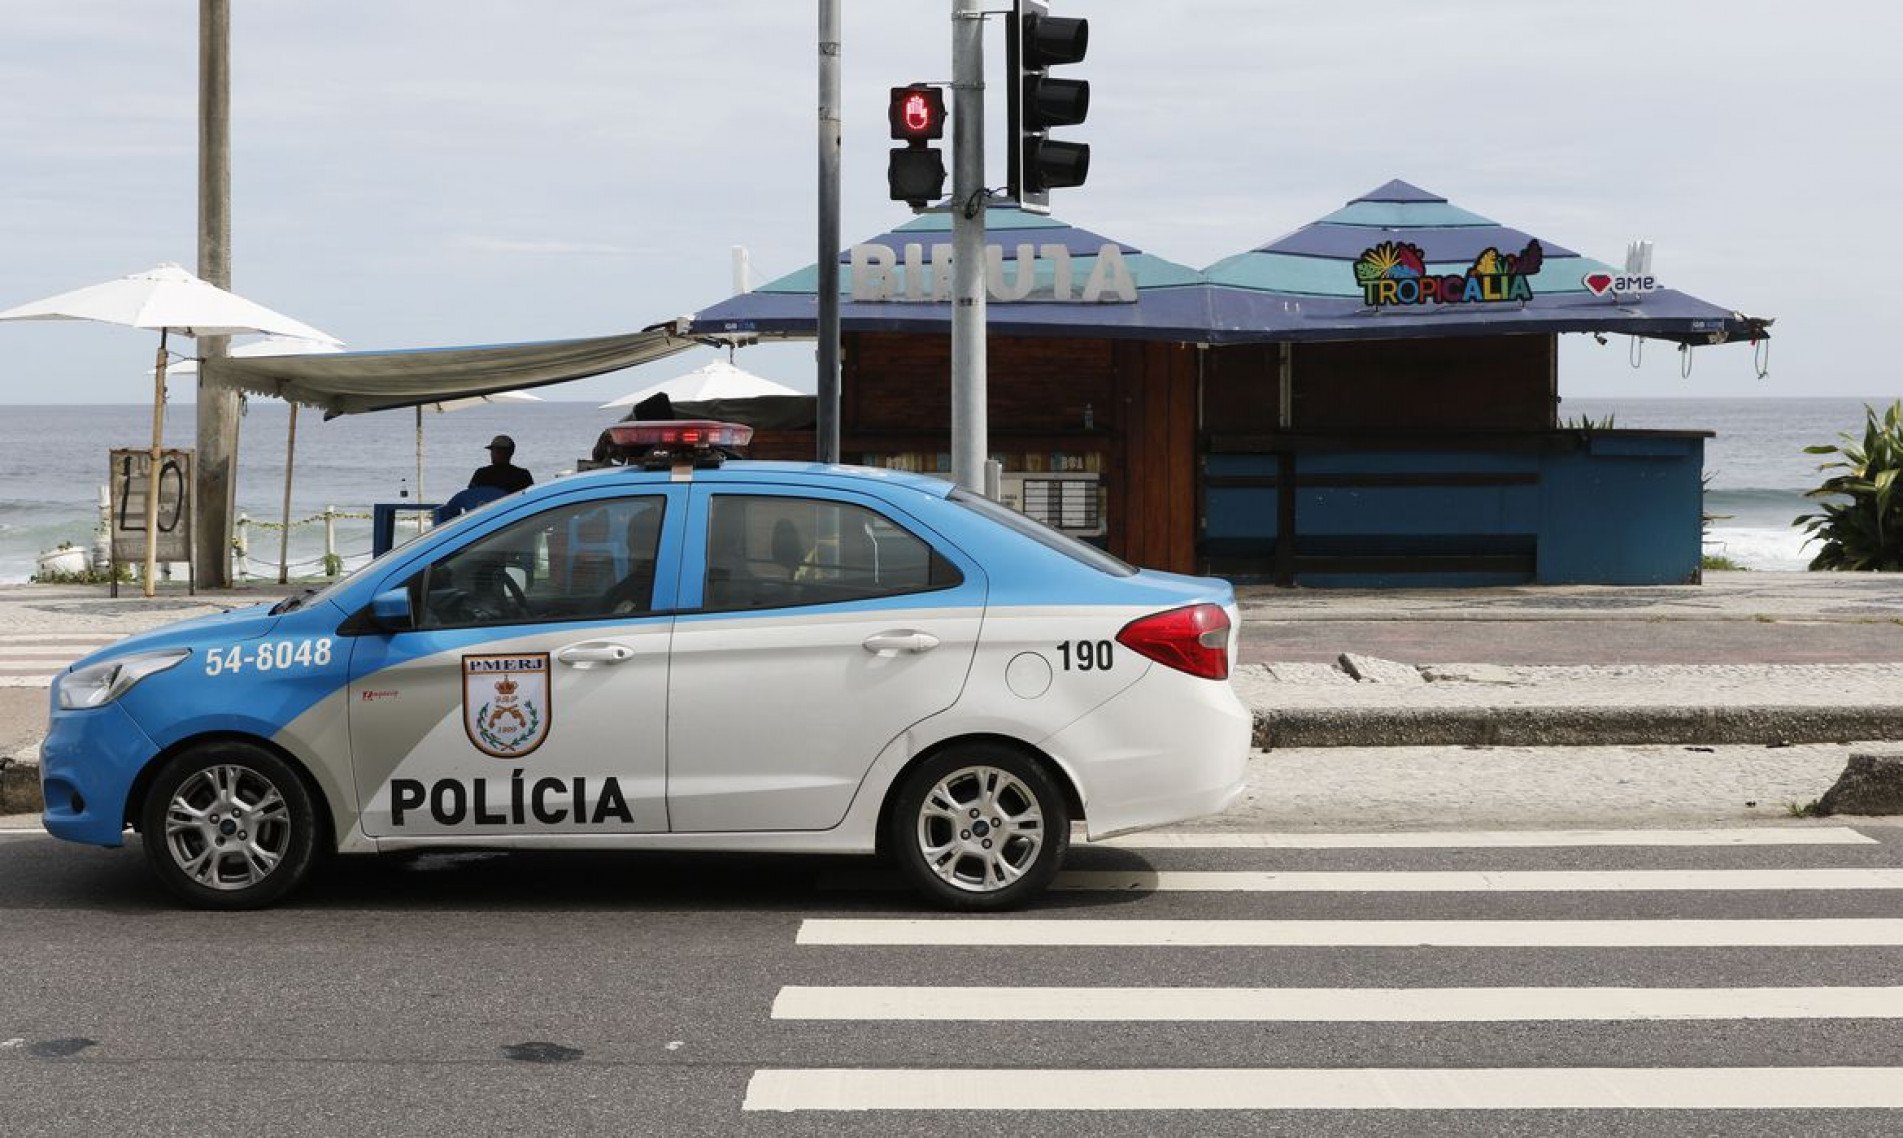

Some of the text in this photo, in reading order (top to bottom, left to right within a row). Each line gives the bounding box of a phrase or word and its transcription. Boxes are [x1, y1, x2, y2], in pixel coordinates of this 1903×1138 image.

[205, 638, 332, 676] 54-8048
[470, 659, 543, 670] PMERJ
[1056, 640, 1113, 671] 190
[391, 769, 635, 826] POLÍCIA
